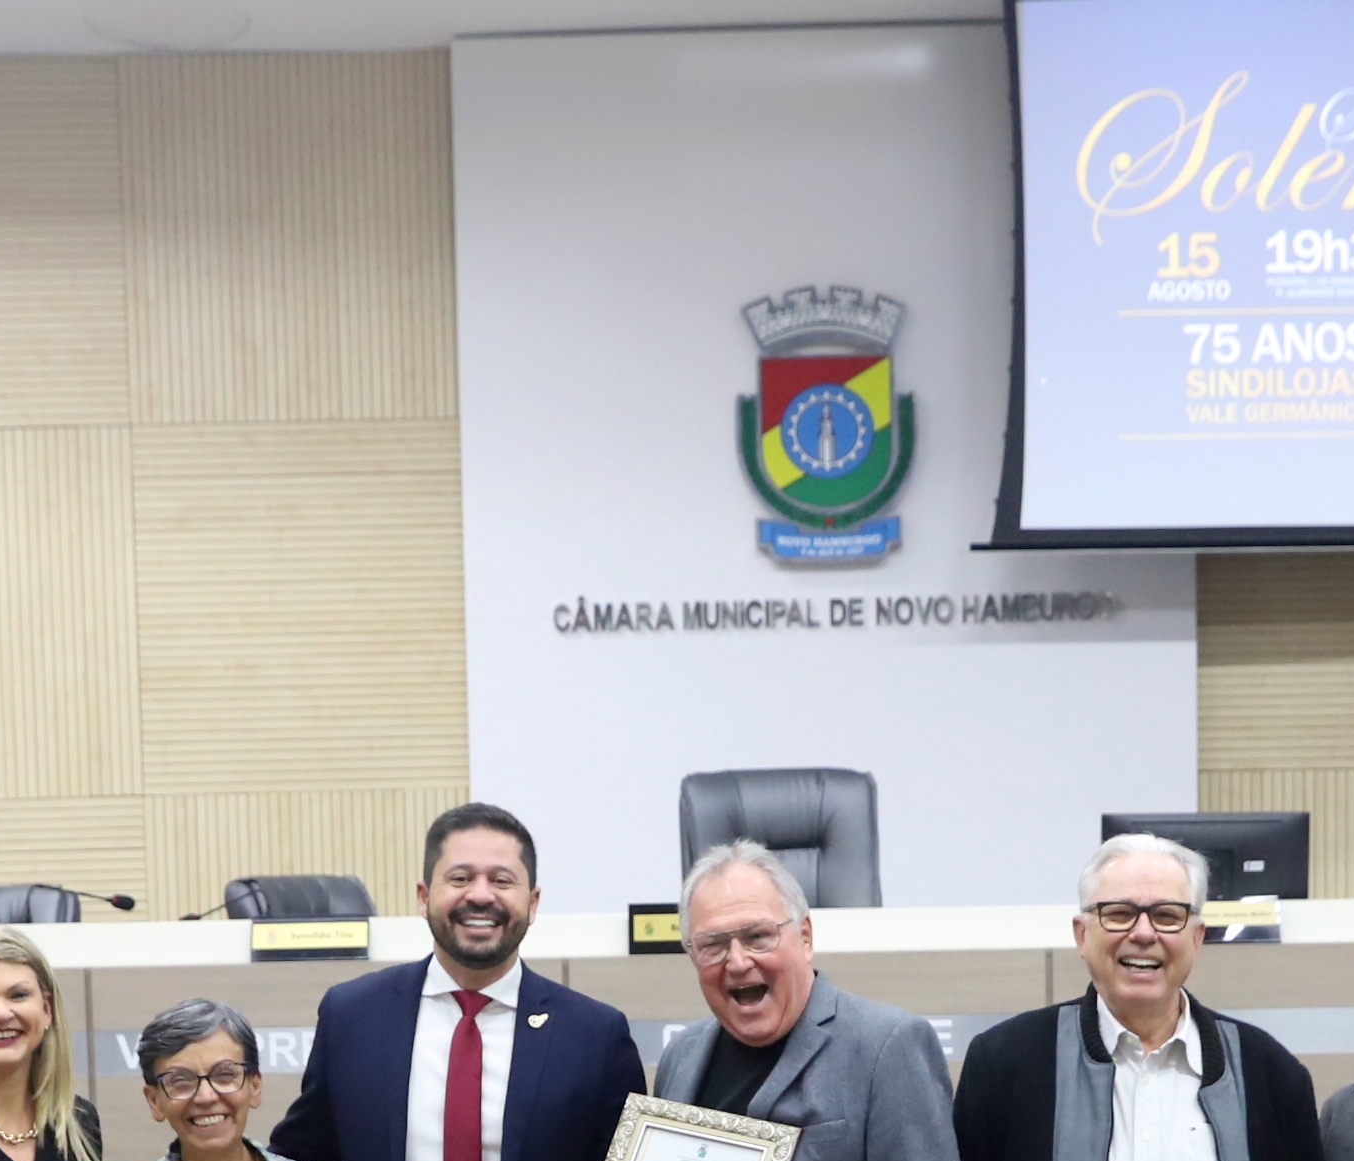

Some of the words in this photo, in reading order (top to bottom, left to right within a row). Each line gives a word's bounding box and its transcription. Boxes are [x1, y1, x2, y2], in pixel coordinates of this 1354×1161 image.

[1156, 232, 1222, 279] 15
[1147, 279, 1232, 302] AGOSTO
[1183, 322, 1242, 365] 75
[1186, 402, 1239, 424] VALE
[553, 595, 675, 633] CÂMARA
[682, 598, 821, 631] MUNICIPAL
[829, 597, 864, 627] DE
[875, 594, 954, 626] NOVO
